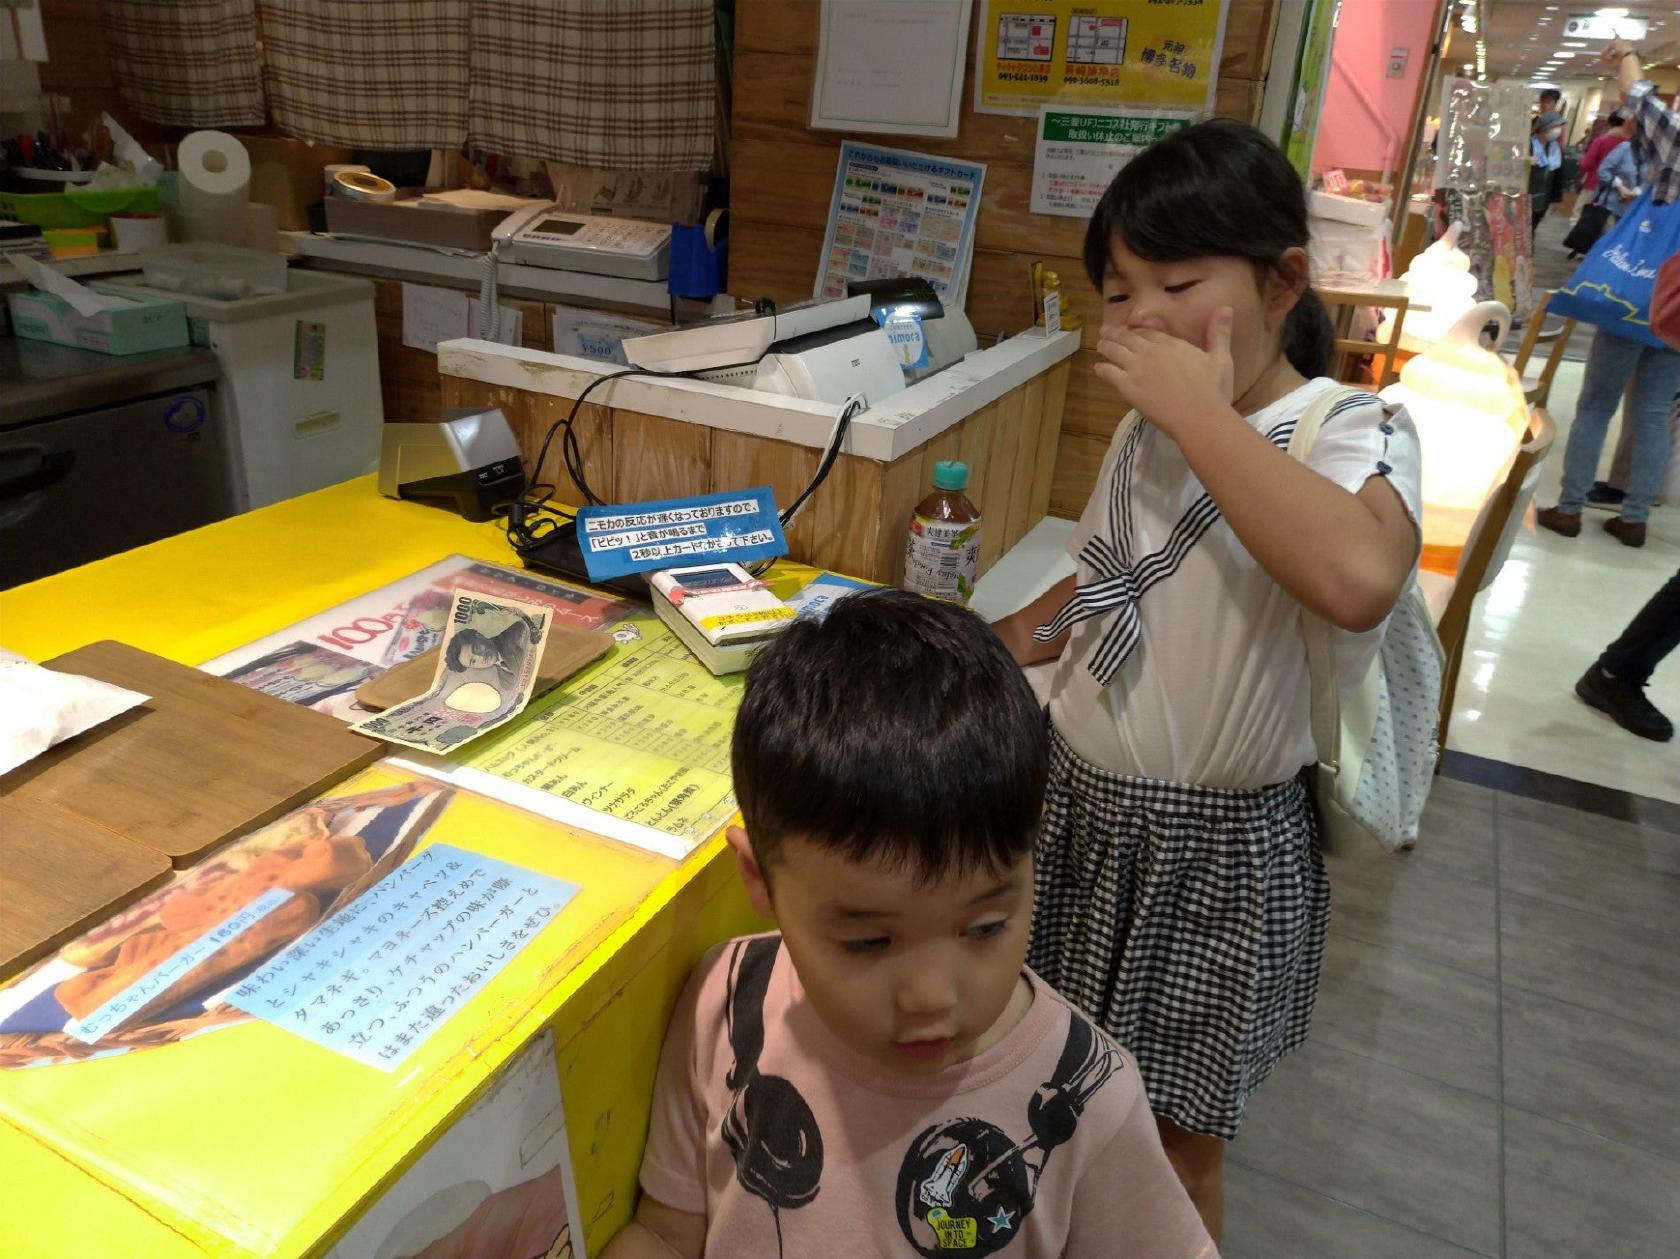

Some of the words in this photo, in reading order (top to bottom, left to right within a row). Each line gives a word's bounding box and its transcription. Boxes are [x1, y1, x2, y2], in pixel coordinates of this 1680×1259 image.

[453, 596, 473, 624] 1000
[936, 1219, 971, 1230] JOURNEY
[942, 1239, 968, 1248] SPACE
